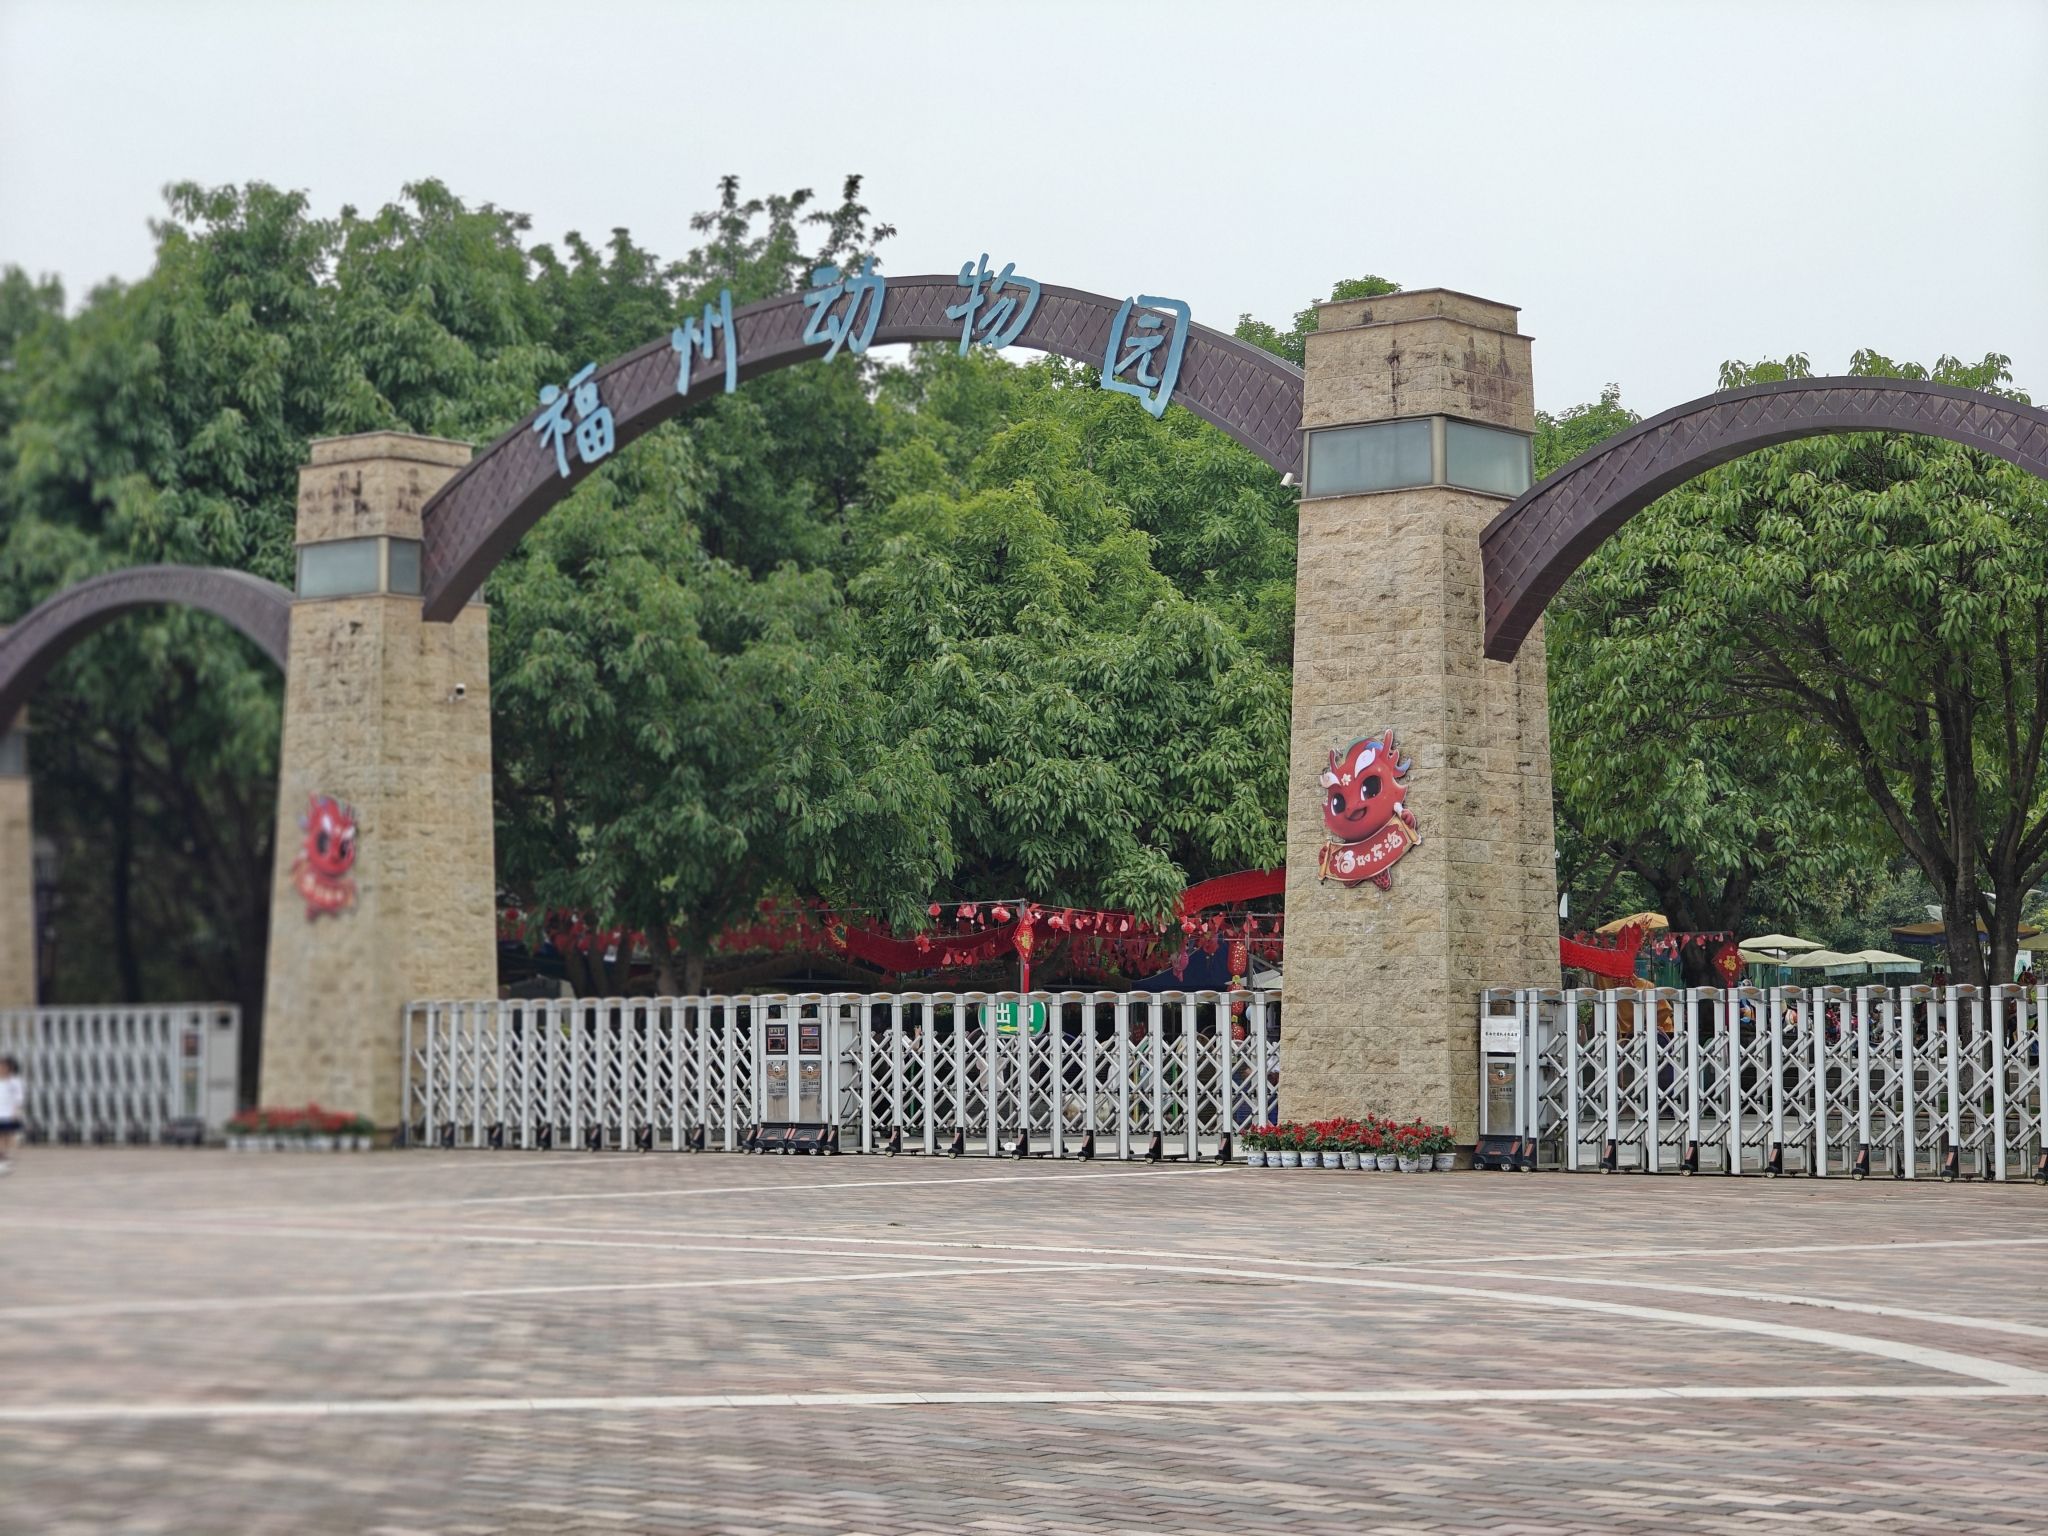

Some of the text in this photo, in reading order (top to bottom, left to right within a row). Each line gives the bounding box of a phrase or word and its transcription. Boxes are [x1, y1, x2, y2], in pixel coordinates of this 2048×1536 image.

[533, 253, 1191, 477] 福州动物园
